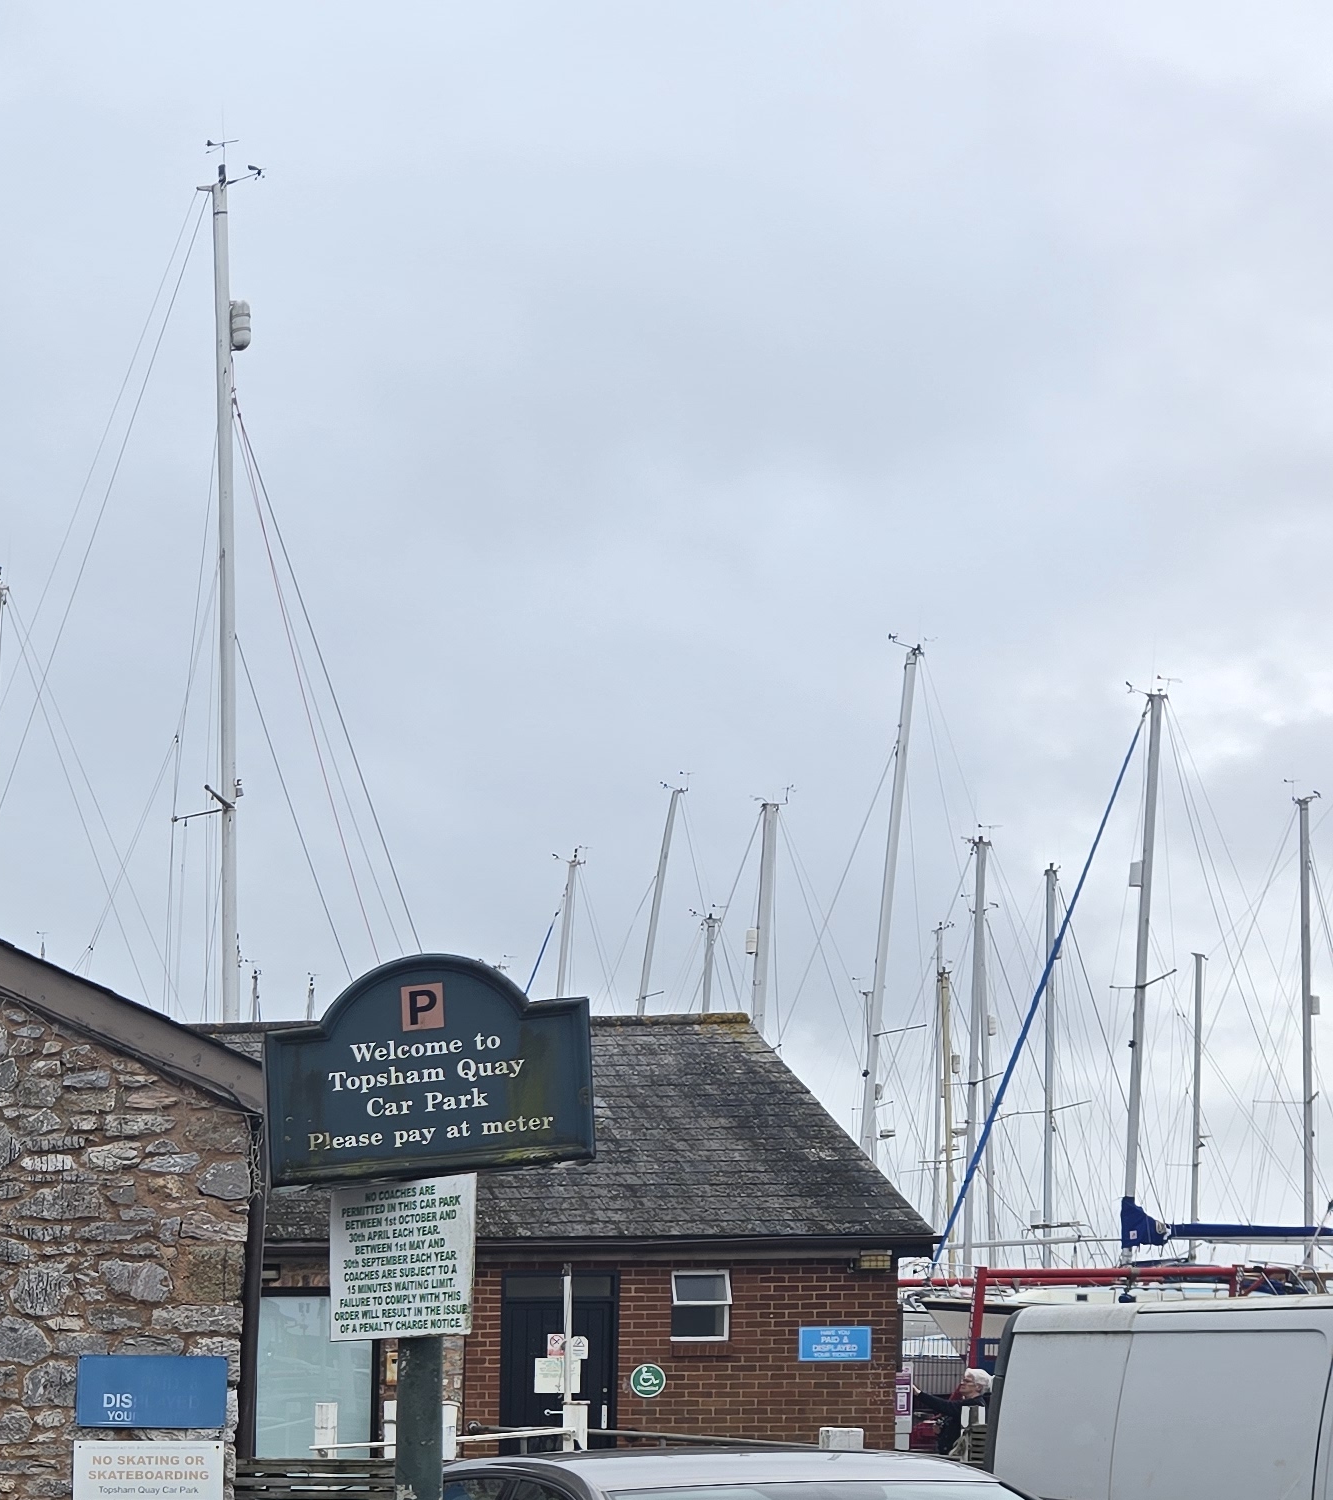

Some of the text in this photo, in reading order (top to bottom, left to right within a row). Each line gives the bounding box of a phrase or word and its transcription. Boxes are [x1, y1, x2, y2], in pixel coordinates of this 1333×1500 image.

[409, 990, 437, 1025] P
[350, 1033, 501, 1062] Welcome to
[328, 1058, 525, 1093] Topsham Quay
[366, 1088, 489, 1117] Car Park
[308, 1115, 554, 1151] Please pay at meter
[365, 1185, 435, 1202] NO COACHES ARE
[342, 1195, 461, 1218] PERMITTED IN THIS CAR PARK
[345, 1210, 456, 1230] BETWEEN 1st OCTOBER AND
[349, 1233, 365, 1242] 30th
[367, 1229, 390, 1241] APRIL
[393, 1227, 413, 1239] EACH
[355, 1238, 445, 1255] BETWEEN 1st MAY AND
[343, 1259, 359, 1269] 30th
[362, 1255, 408, 1267] SEPTEMBER
[410, 1253, 431, 1263] EACH
[344, 1264, 457, 1282] COACHES ARE SUBJECT TO A
[348, 1278, 455, 1294] 15 MINUTES WAITING LIMIT.
[340, 1291, 461, 1308] FAILURE TO COMPLY WITH THIS
[335, 1304, 467, 1321] ORDER WILL RESULT IN THE ISSUE
[340, 1324, 350, 1333] OF
[352, 1324, 357, 1333] A
[360, 1321, 393, 1332] PENALTY
[396, 1319, 428, 1330] CHARGE
[92, 1456, 204, 1465] NO SKATING OR
[89, 1471, 209, 1480] SKATEBOARDING
[99, 1486, 198, 1495] Topsham Quay Car Park
